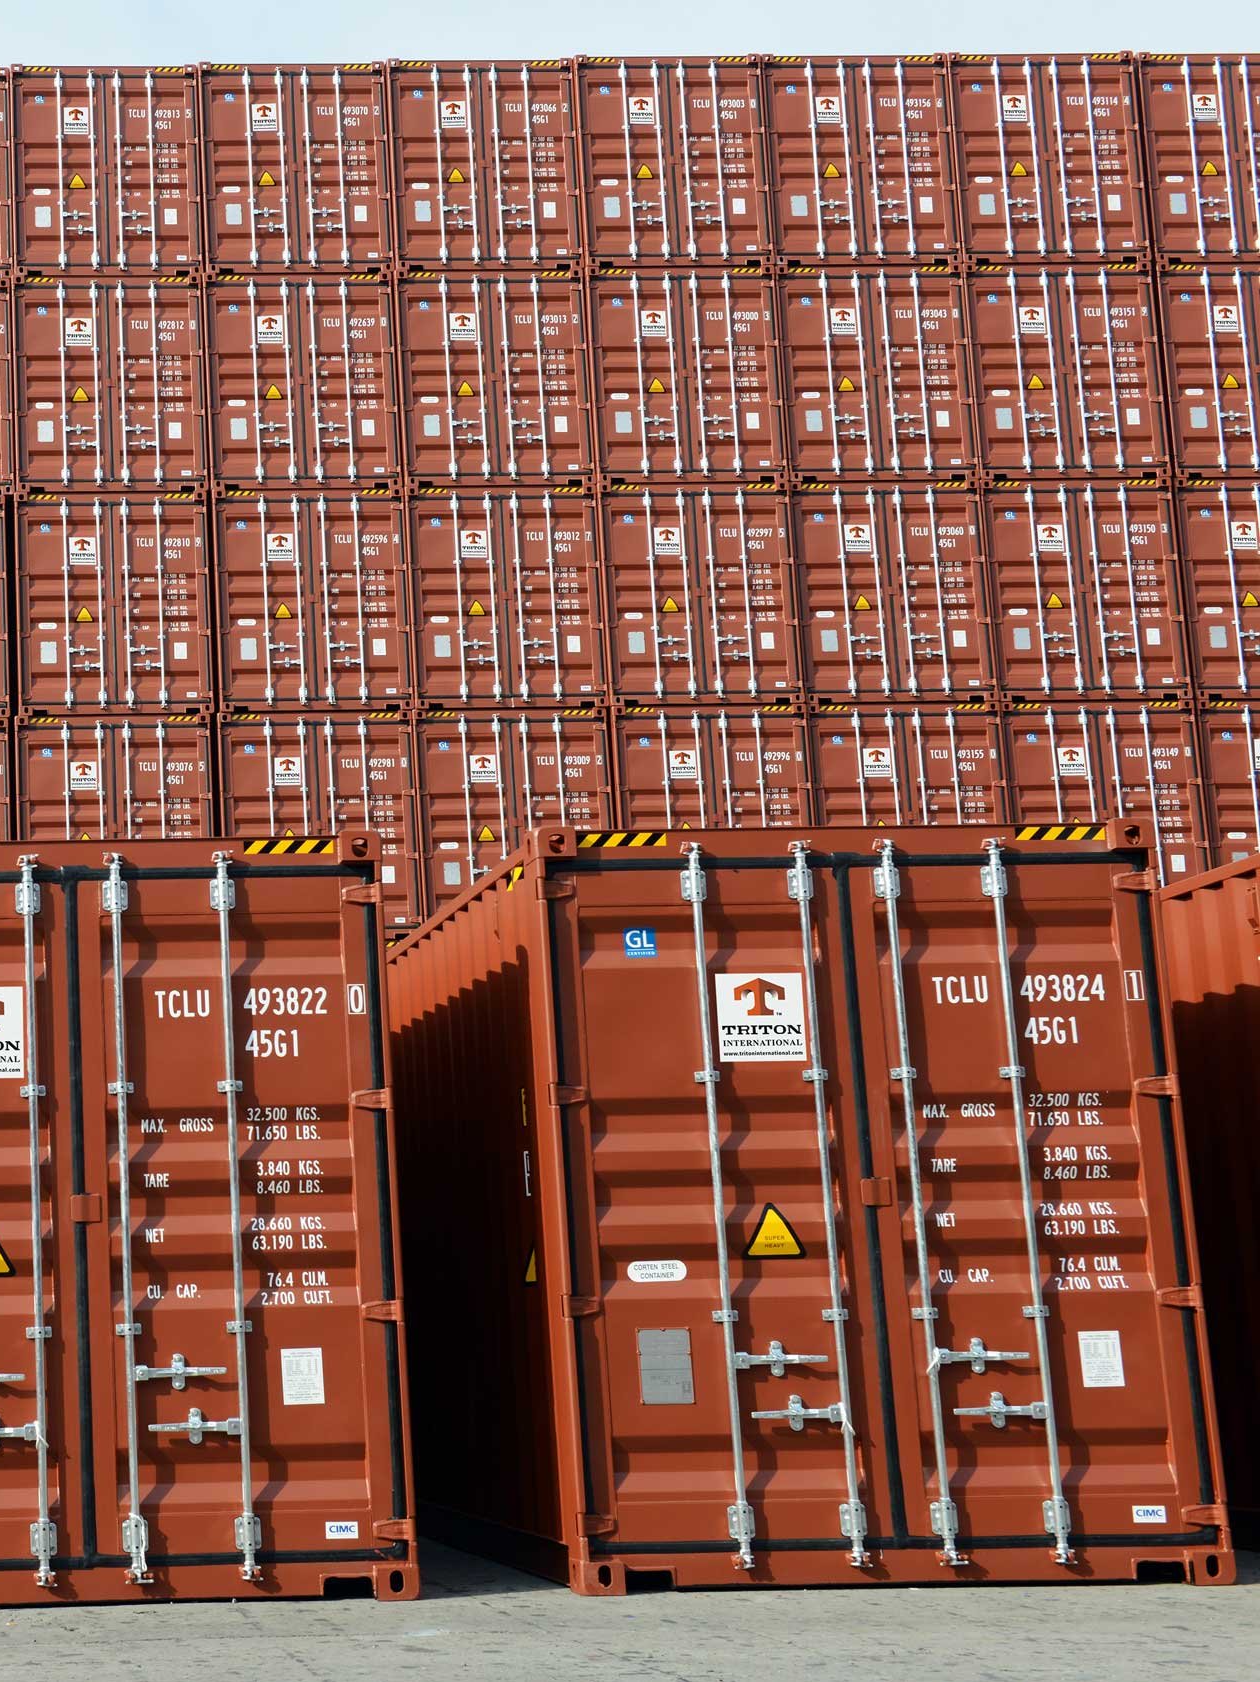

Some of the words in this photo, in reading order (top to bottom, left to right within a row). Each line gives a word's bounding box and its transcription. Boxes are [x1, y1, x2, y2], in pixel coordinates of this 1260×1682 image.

[879, 98, 897, 107] TCLU
[905, 98, 931, 107] 493156
[906, 110, 923, 119] 45G1
[894, 309, 913, 319] TCLU
[920, 309, 947, 318] 493043
[130, 320, 149, 330] TCLU
[157, 320, 184, 330] 492812
[921, 320, 939, 330] 45G1
[158, 332, 176, 341] 45G1
[1102, 524, 1120, 534] TCLU
[1129, 524, 1156, 533] 493150
[1130, 535, 1148, 545] 45G1
[735, 752, 754, 761] TCLU
[763, 752, 790, 761] 492996
[139, 762, 157, 772] TCLU
[165, 762, 193, 771] 493076
[764, 764, 782, 773] 45G1
[166, 775, 184, 785] 45G1
[625, 930, 654, 949] GL
[931, 975, 988, 1004] TCLU
[1020, 974, 1105, 1003] 493824
[1129, 972, 1140, 999] 1
[154, 989, 210, 1019] TCLU
[243, 987, 327, 1016] 493822
[350, 986, 363, 1012] 0
[722, 1025, 802, 1035] TRITON
[1024, 1016, 1078, 1044] 45G1
[245, 1029, 299, 1057] 45G1
[1078, 1092, 1102, 1106] KGS.
[295, 1107, 321, 1120] KGS.
[922, 1104, 949, 1118] MAX.
[961, 1103, 996, 1118] GROSS
[141, 1118, 167, 1133] MAX.
[179, 1117, 214, 1132] GROSS
[1077, 1111, 1103, 1125] LBS.
[295, 1125, 321, 1140] LBS.
[1085, 1146, 1112, 1161] KGS.
[298, 1160, 324, 1176] KGS.
[930, 1158, 956, 1173] TARE
[1085, 1165, 1111, 1179] LBS.
[144, 1173, 169, 1188] TARE
[299, 1180, 324, 1194] LBS.
[1088, 1202, 1117, 1215] KGS.
[300, 1216, 326, 1230] KGS.
[935, 1213, 956, 1228] NET
[1093, 1220, 1120, 1234] LBS.
[145, 1228, 165, 1243] NET
[301, 1235, 327, 1249] LBS.
[1059, 1257, 1086, 1273] 76.4
[1094, 1256, 1121, 1272] CU.M.
[267, 1272, 293, 1288] 76.4
[302, 1271, 328, 1287] CU.M.
[938, 1269, 958, 1284] CU.
[967, 1268, 994, 1283] CAP.
[1097, 1275, 1129, 1289] CU.FT.
[147, 1285, 165, 1300] CU.
[176, 1284, 201, 1298] CAP.
[303, 1290, 333, 1304] CU.FT.
[1136, 1509, 1163, 1517] CIMC
[329, 1525, 356, 1533] CIMC
